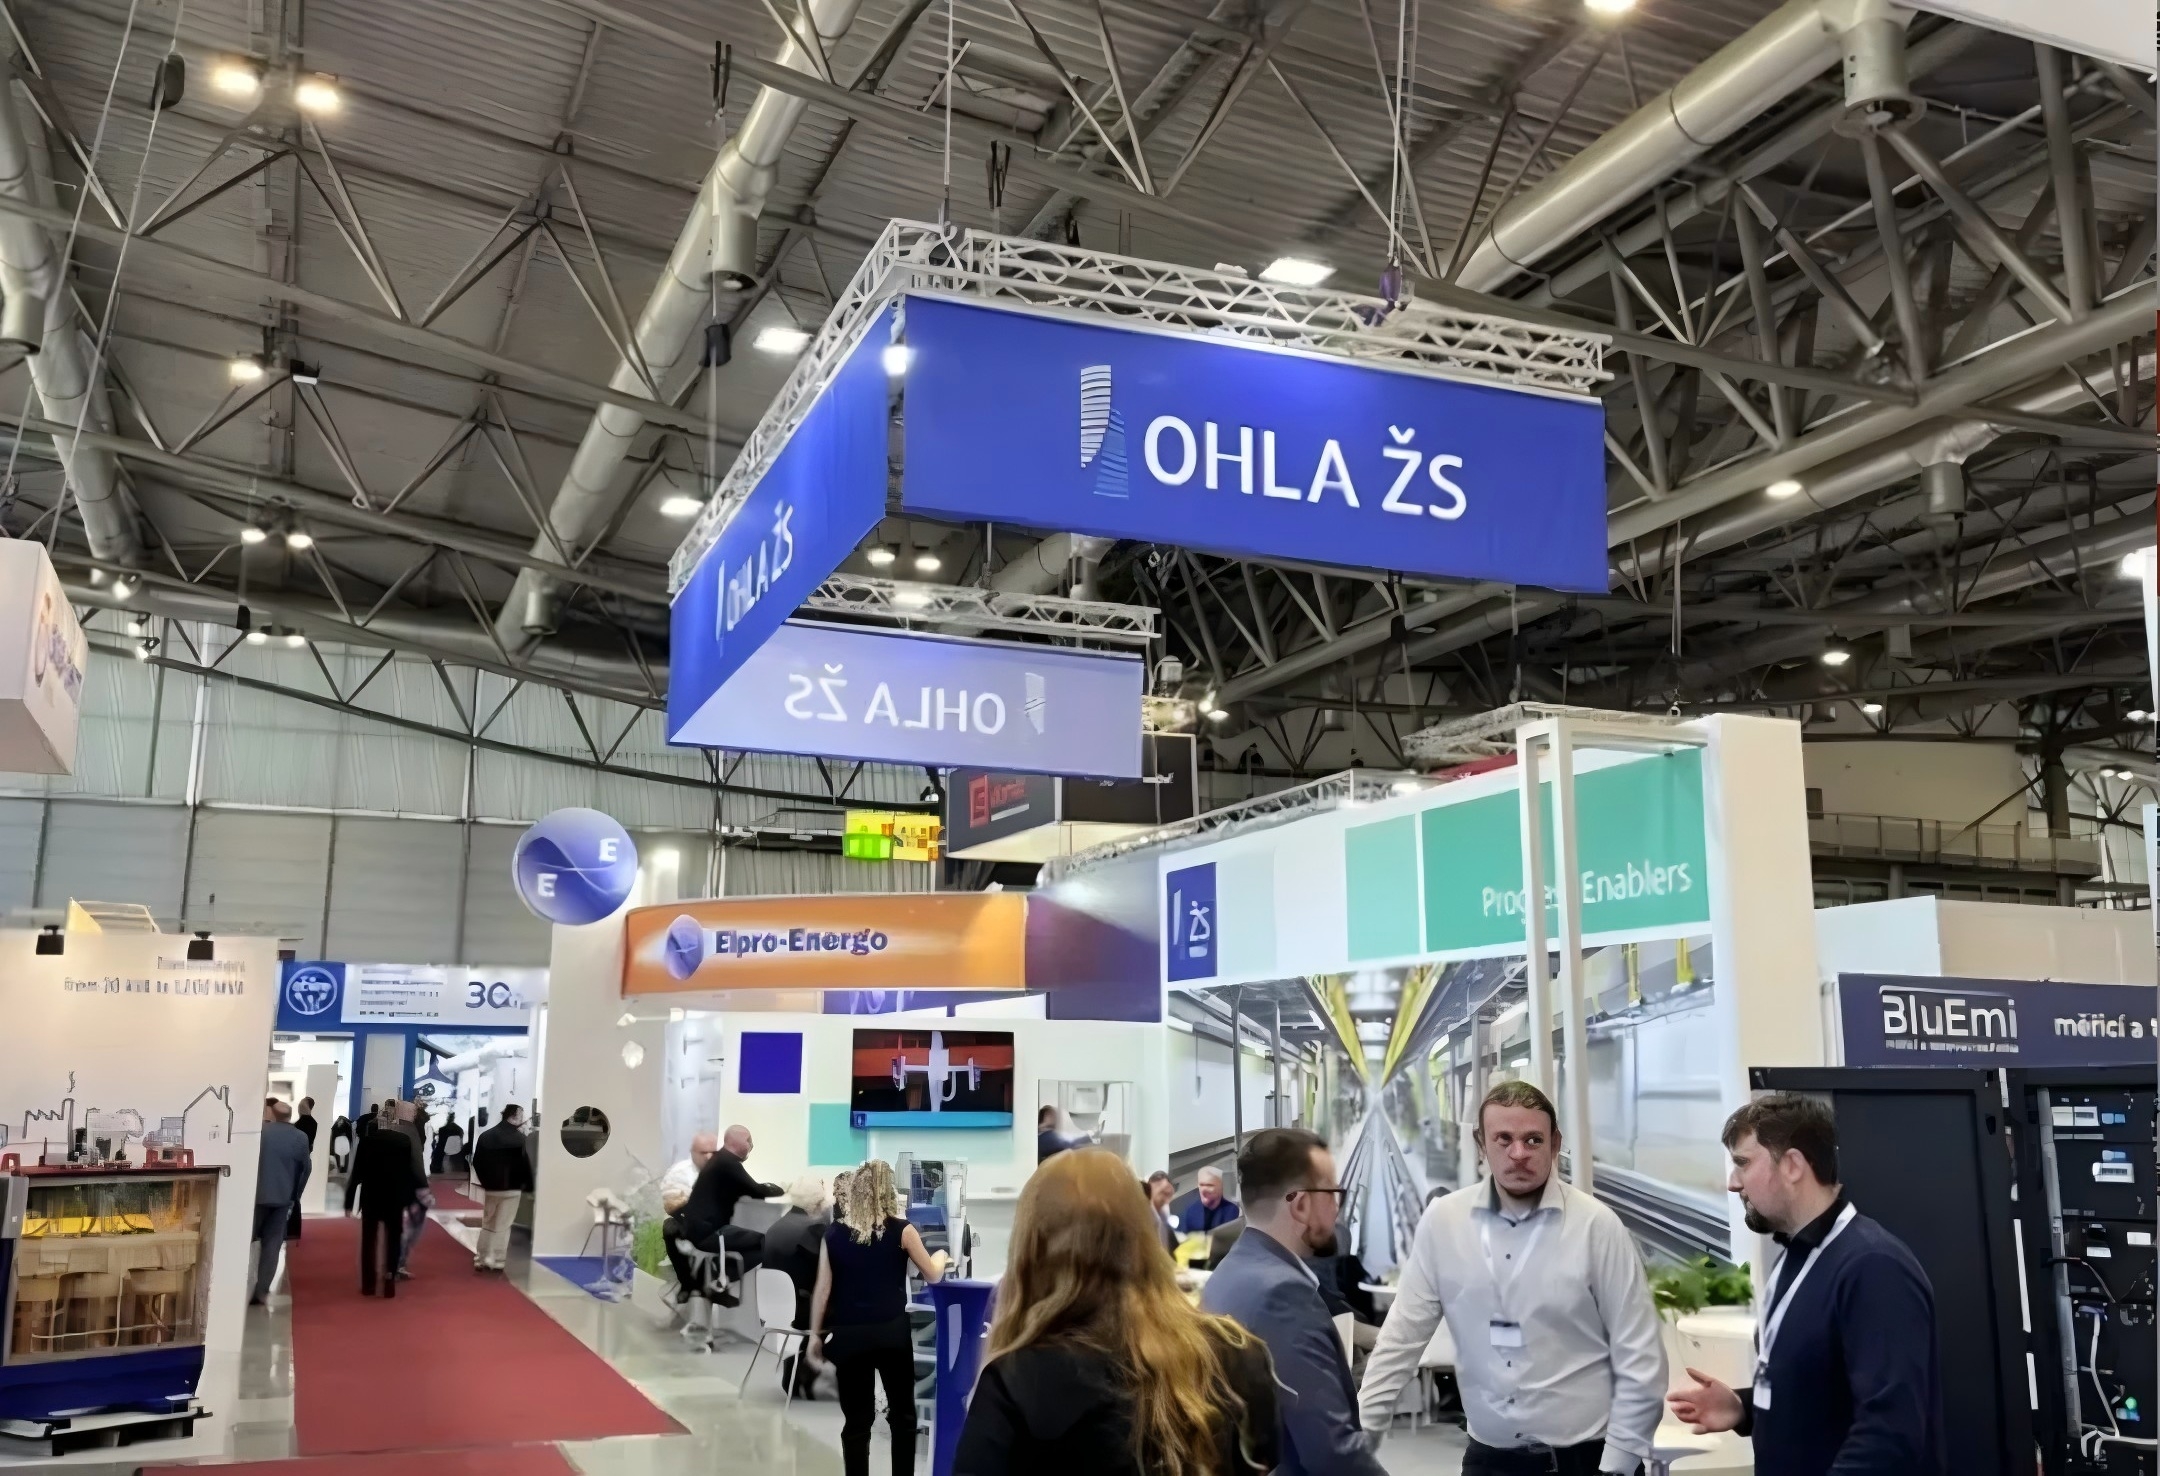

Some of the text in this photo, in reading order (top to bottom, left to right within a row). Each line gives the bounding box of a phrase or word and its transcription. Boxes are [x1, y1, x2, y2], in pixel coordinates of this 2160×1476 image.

[1144, 415, 1468, 521] OHLA ŽS
[598, 837, 620, 862] E
[537, 873, 559, 898] E
[1580, 859, 1693, 905] Enablers
[715, 928, 888, 958] Elpro-Energo
[1881, 994, 2018, 1040] BluEmi
[2129, 1021, 2144, 1039] a
